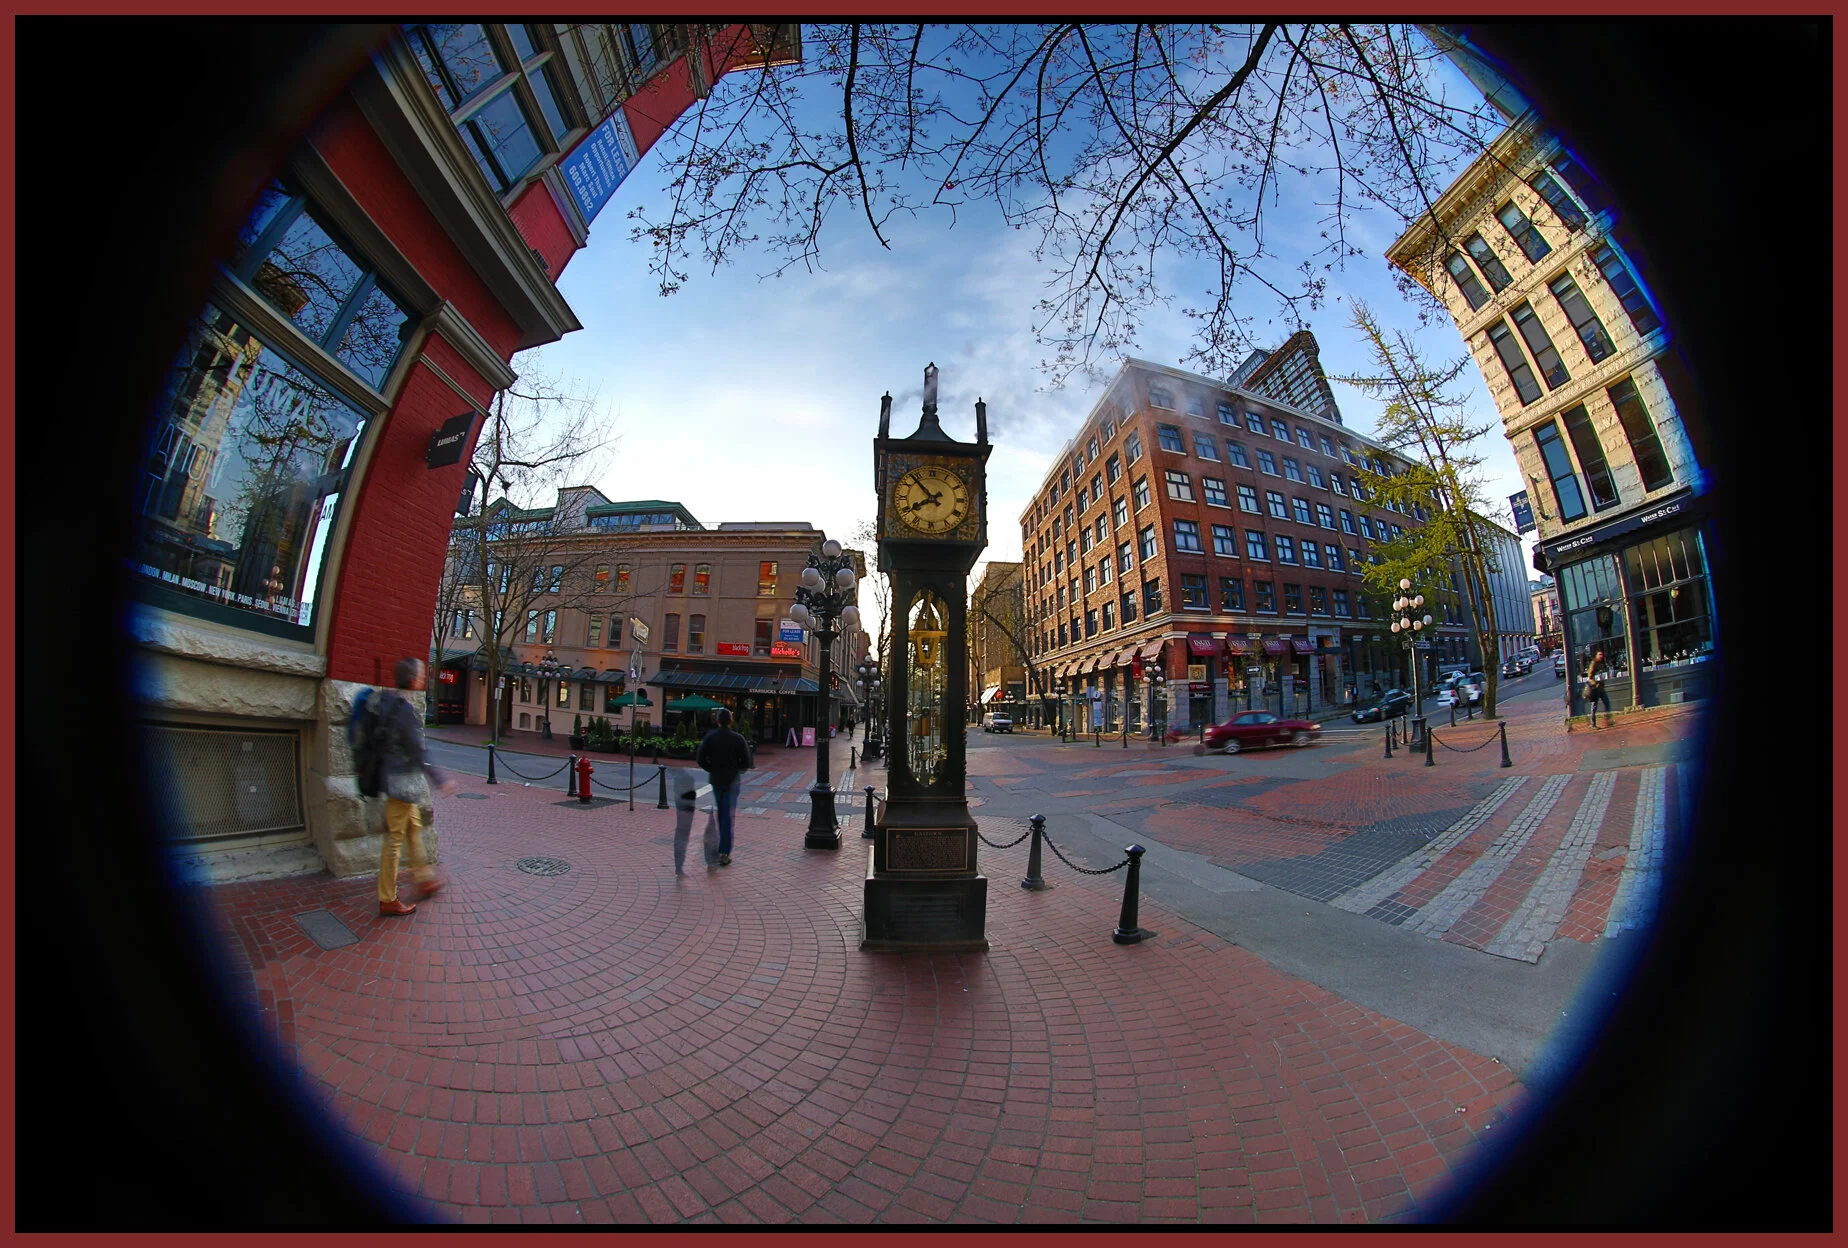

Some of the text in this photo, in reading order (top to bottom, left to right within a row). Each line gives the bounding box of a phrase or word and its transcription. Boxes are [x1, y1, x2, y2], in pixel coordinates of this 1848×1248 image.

[583, 152, 595, 177] Robert
[591, 142, 612, 188] Opportunities
[602, 124, 626, 178] FOR LEASE
[568, 165, 594, 212] 609.0882
[578, 162, 590, 183] Marc
[162, 571, 180, 585] MILAN
[182, 577, 207, 593] MOSCOW
[208, 585, 221, 598] NEW
[221, 587, 235, 601] YORK
[237, 593, 252, 606] PARIS
[771, 647, 800, 656] Michelle's
